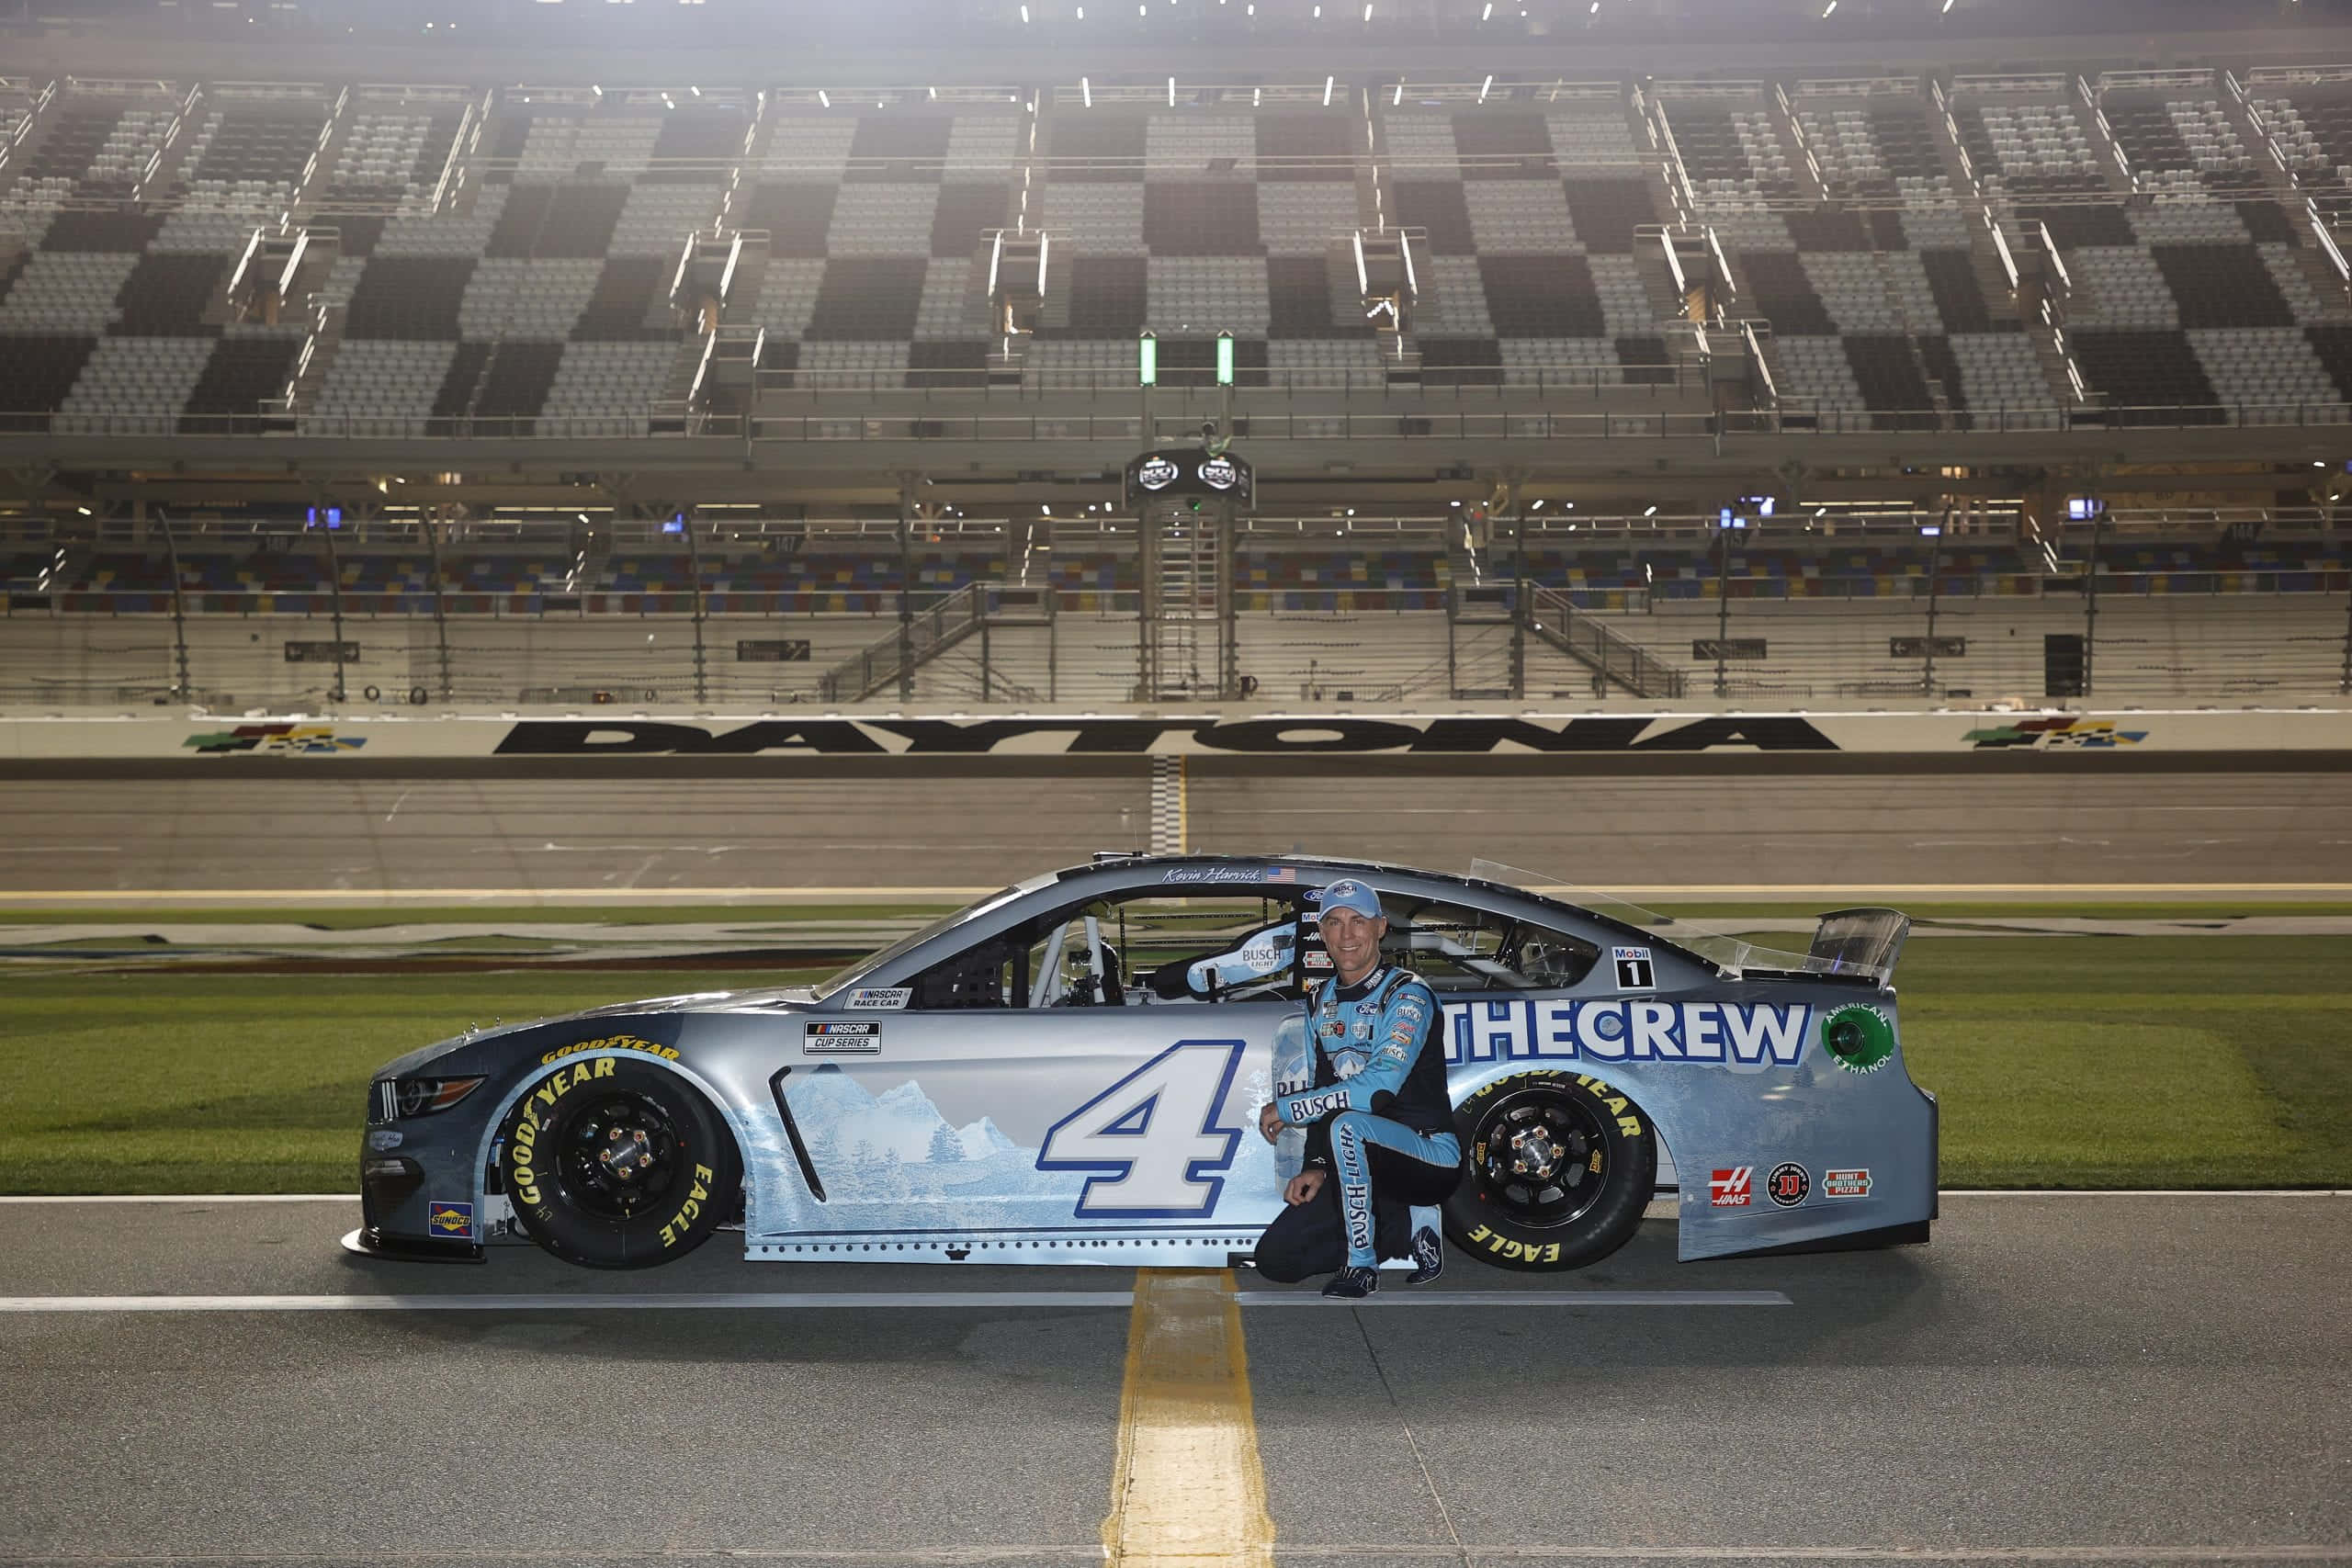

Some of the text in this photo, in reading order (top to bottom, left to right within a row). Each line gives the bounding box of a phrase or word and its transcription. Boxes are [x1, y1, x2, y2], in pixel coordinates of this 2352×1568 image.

[493, 719, 1841, 753] DAYTONA
[1161, 868, 1201, 882] Kevin
[1242, 948, 1281, 962] BUSCH
[1615, 949, 1648, 958] Mobil
[1626, 961, 1640, 985] 1
[867, 990, 902, 998] NASCAR
[1826, 1002, 1887, 1023] AMERICAN
[830, 1024, 869, 1033] NASCAR
[541, 1035, 680, 1066] GOODYEAR
[815, 1038, 870, 1046] CUP SERIES
[1833, 1054, 1892, 1075] ETHANOL
[1290, 1090, 1348, 1122] BUSCH
[513, 1057, 616, 1204] GOODYEAR
[1035, 1039, 1246, 1218] 4
[1340, 1123, 1369, 1249] BUSCH LIGHT
[1779, 1175, 1800, 1196] JJ
[1836, 1172, 1859, 1180] HUNT
[659, 1163, 713, 1247] EAGLE
[432, 1214, 471, 1226] SUNOCO
[1467, 1223, 1560, 1262] EAGLE
